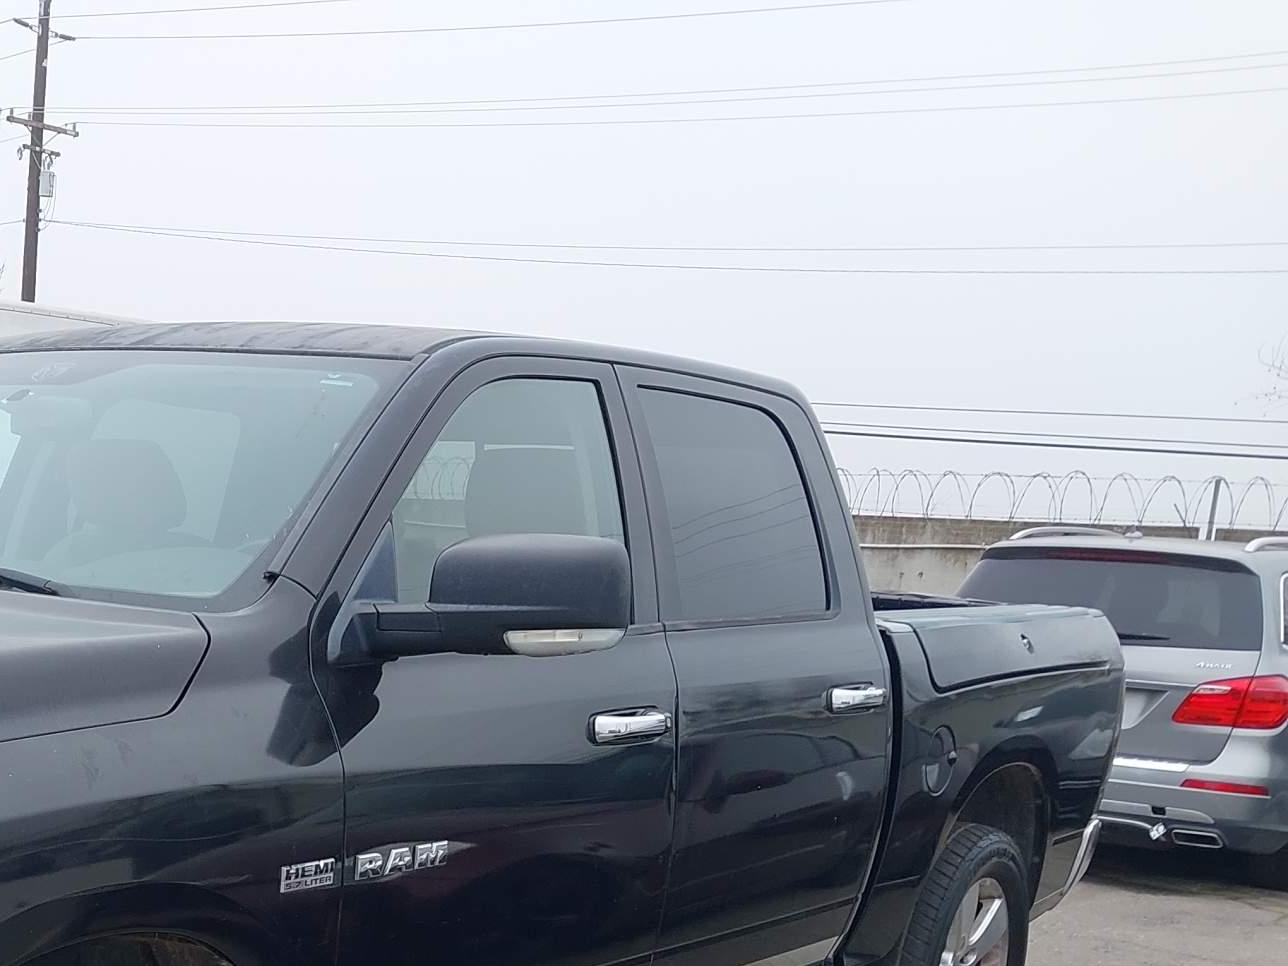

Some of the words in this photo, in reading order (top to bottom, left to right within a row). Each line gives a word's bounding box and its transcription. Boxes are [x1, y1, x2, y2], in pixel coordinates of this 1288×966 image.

[354, 840, 449, 881] RAM
[284, 861, 334, 881] HEMI
[304, 875, 332, 887] LITER
